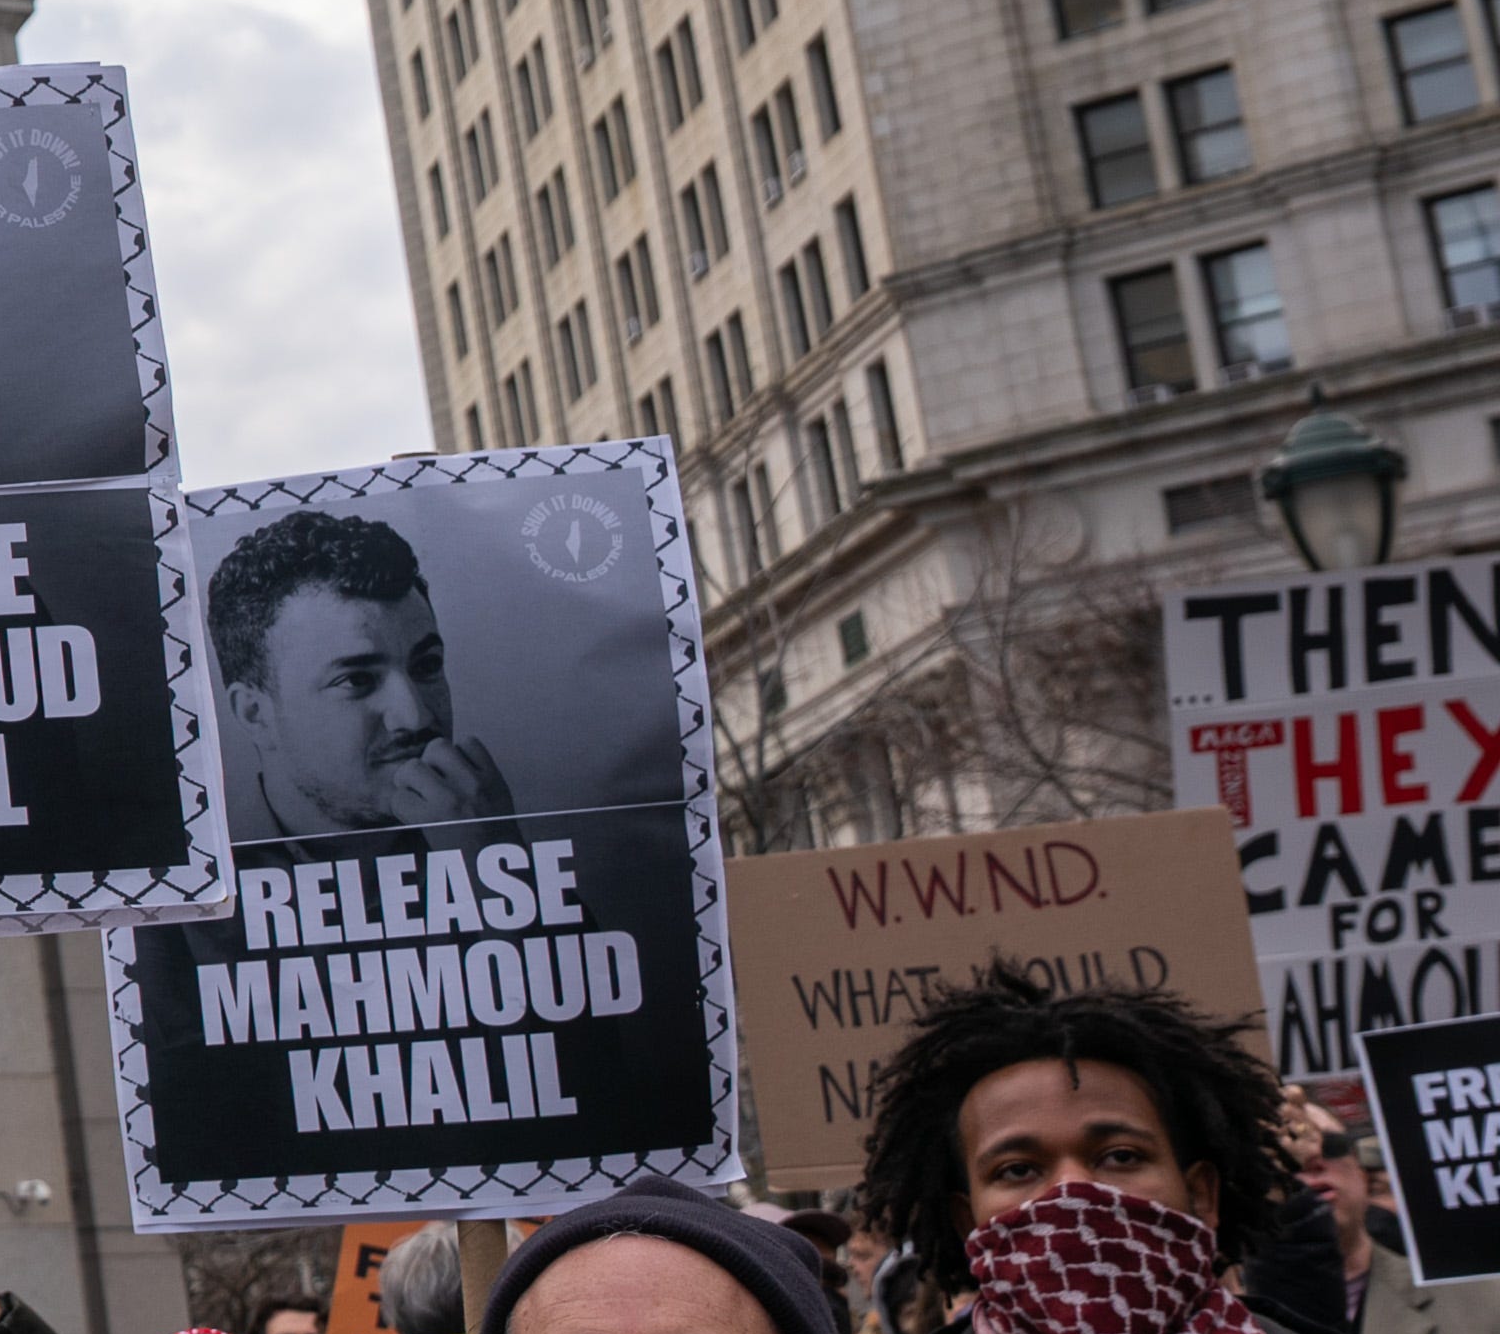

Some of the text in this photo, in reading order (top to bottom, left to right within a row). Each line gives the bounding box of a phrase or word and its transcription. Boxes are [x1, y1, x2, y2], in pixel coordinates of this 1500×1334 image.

[8, 129, 24, 147] IT
[31, 129, 81, 169] DOWN!
[7, 175, 81, 228] PALESTINE
[521, 494, 622, 537] SHUT IT DOWN!
[525, 534, 623, 582] FOR PALESTINE
[238, 838, 584, 951] RELEASE
[1330, 889, 1450, 951] FOR
[195, 929, 642, 1046] MAHMOUD
[791, 945, 1170, 1029] WHAT OULD
[287, 1031, 577, 1133] KHALIL
